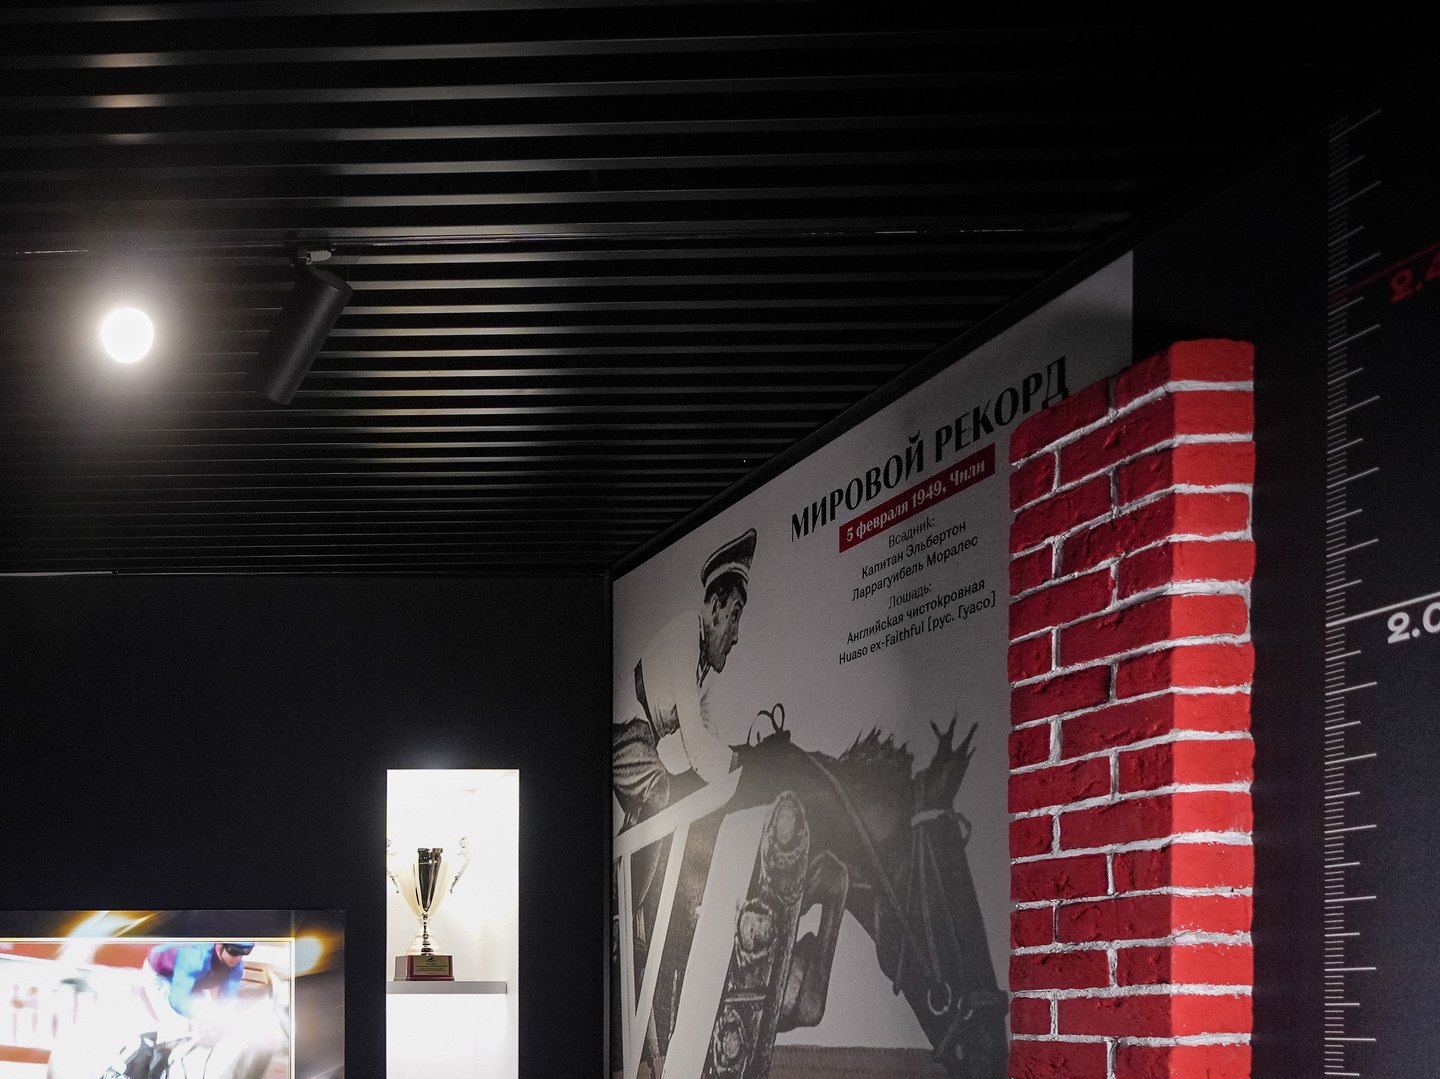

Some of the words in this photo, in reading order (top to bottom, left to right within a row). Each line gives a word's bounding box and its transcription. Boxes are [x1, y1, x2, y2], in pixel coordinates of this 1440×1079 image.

[791, 429, 924, 542] МИРОВОЙ
[935, 356, 1070, 463] РЕКОРД
[846, 527, 855, 542] 5
[856, 500, 909, 539] февраля
[910, 483, 947, 511] 1949,
[949, 458, 986, 487] Чили
[888, 516, 935, 548] Всадник:
[852, 562, 924, 602] Ларрагуибель
[926, 535, 978, 568] Моралес
[862, 550, 904, 579] Капитан
[906, 521, 966, 558] Эльбертон
[839, 646, 868, 665] Huaso
[870, 620, 925, 653] ex-Faithful
[928, 613, 955, 633] [рус.
[959, 590, 996, 621] Гуасо]
[847, 614, 904, 644] Английская
[906, 579, 985, 619] чистокровная
[888, 583, 933, 610] Лошадь:
